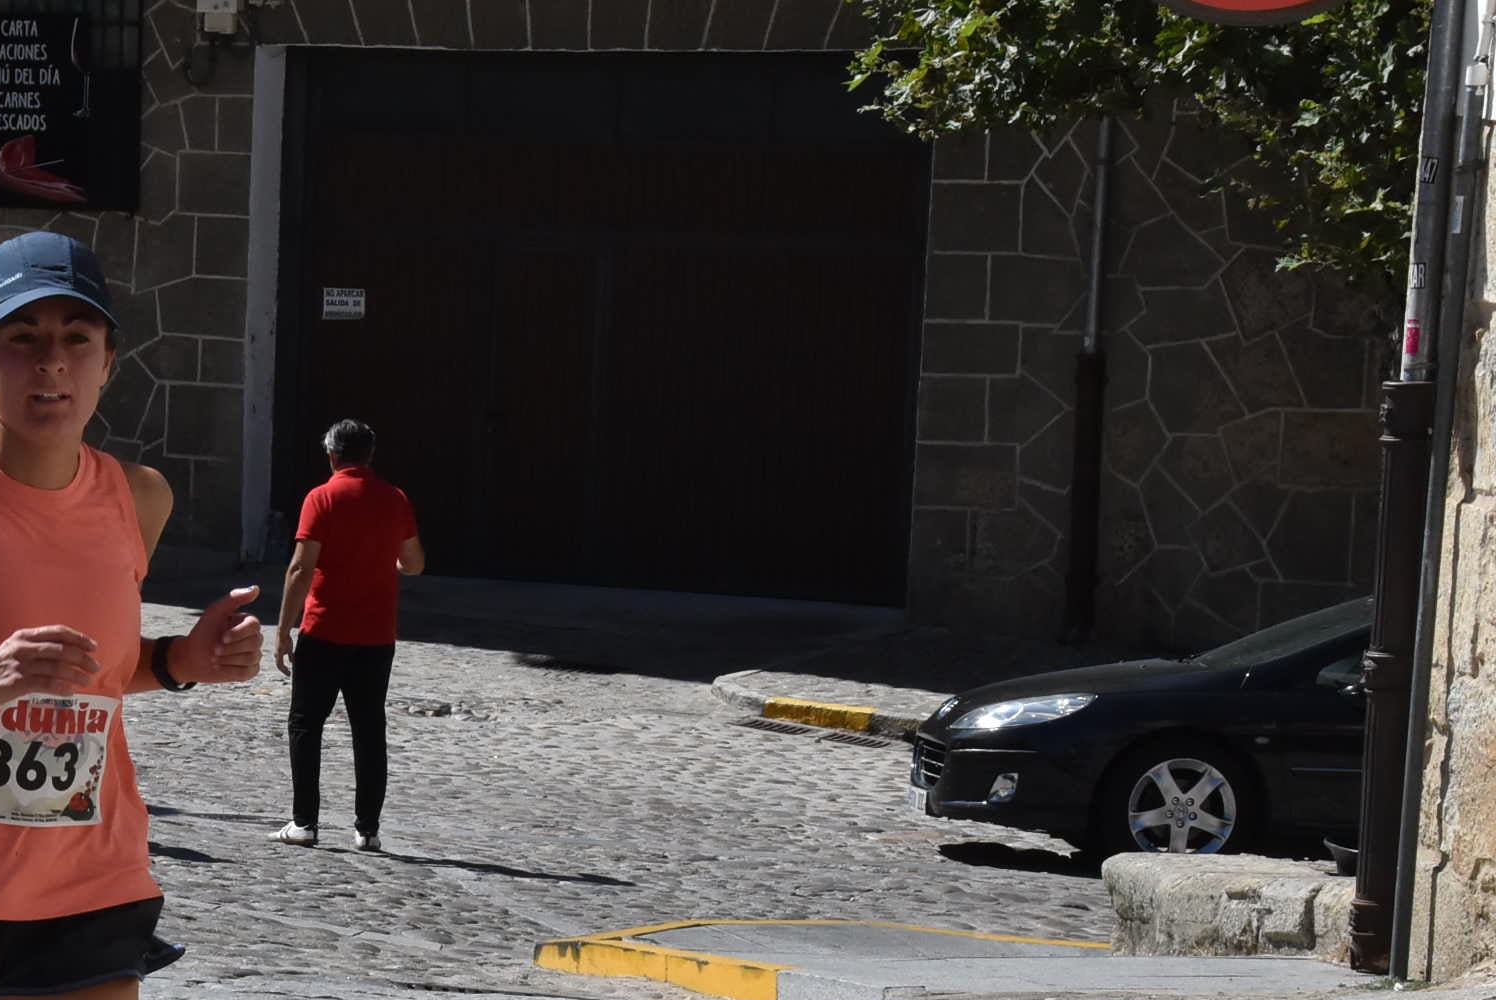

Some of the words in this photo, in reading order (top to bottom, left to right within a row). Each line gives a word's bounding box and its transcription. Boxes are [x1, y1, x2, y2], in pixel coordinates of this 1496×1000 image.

[0, 19, 39, 38] CARTA
[14, 67, 35, 85] DEL
[39, 64, 61, 85] DÍA
